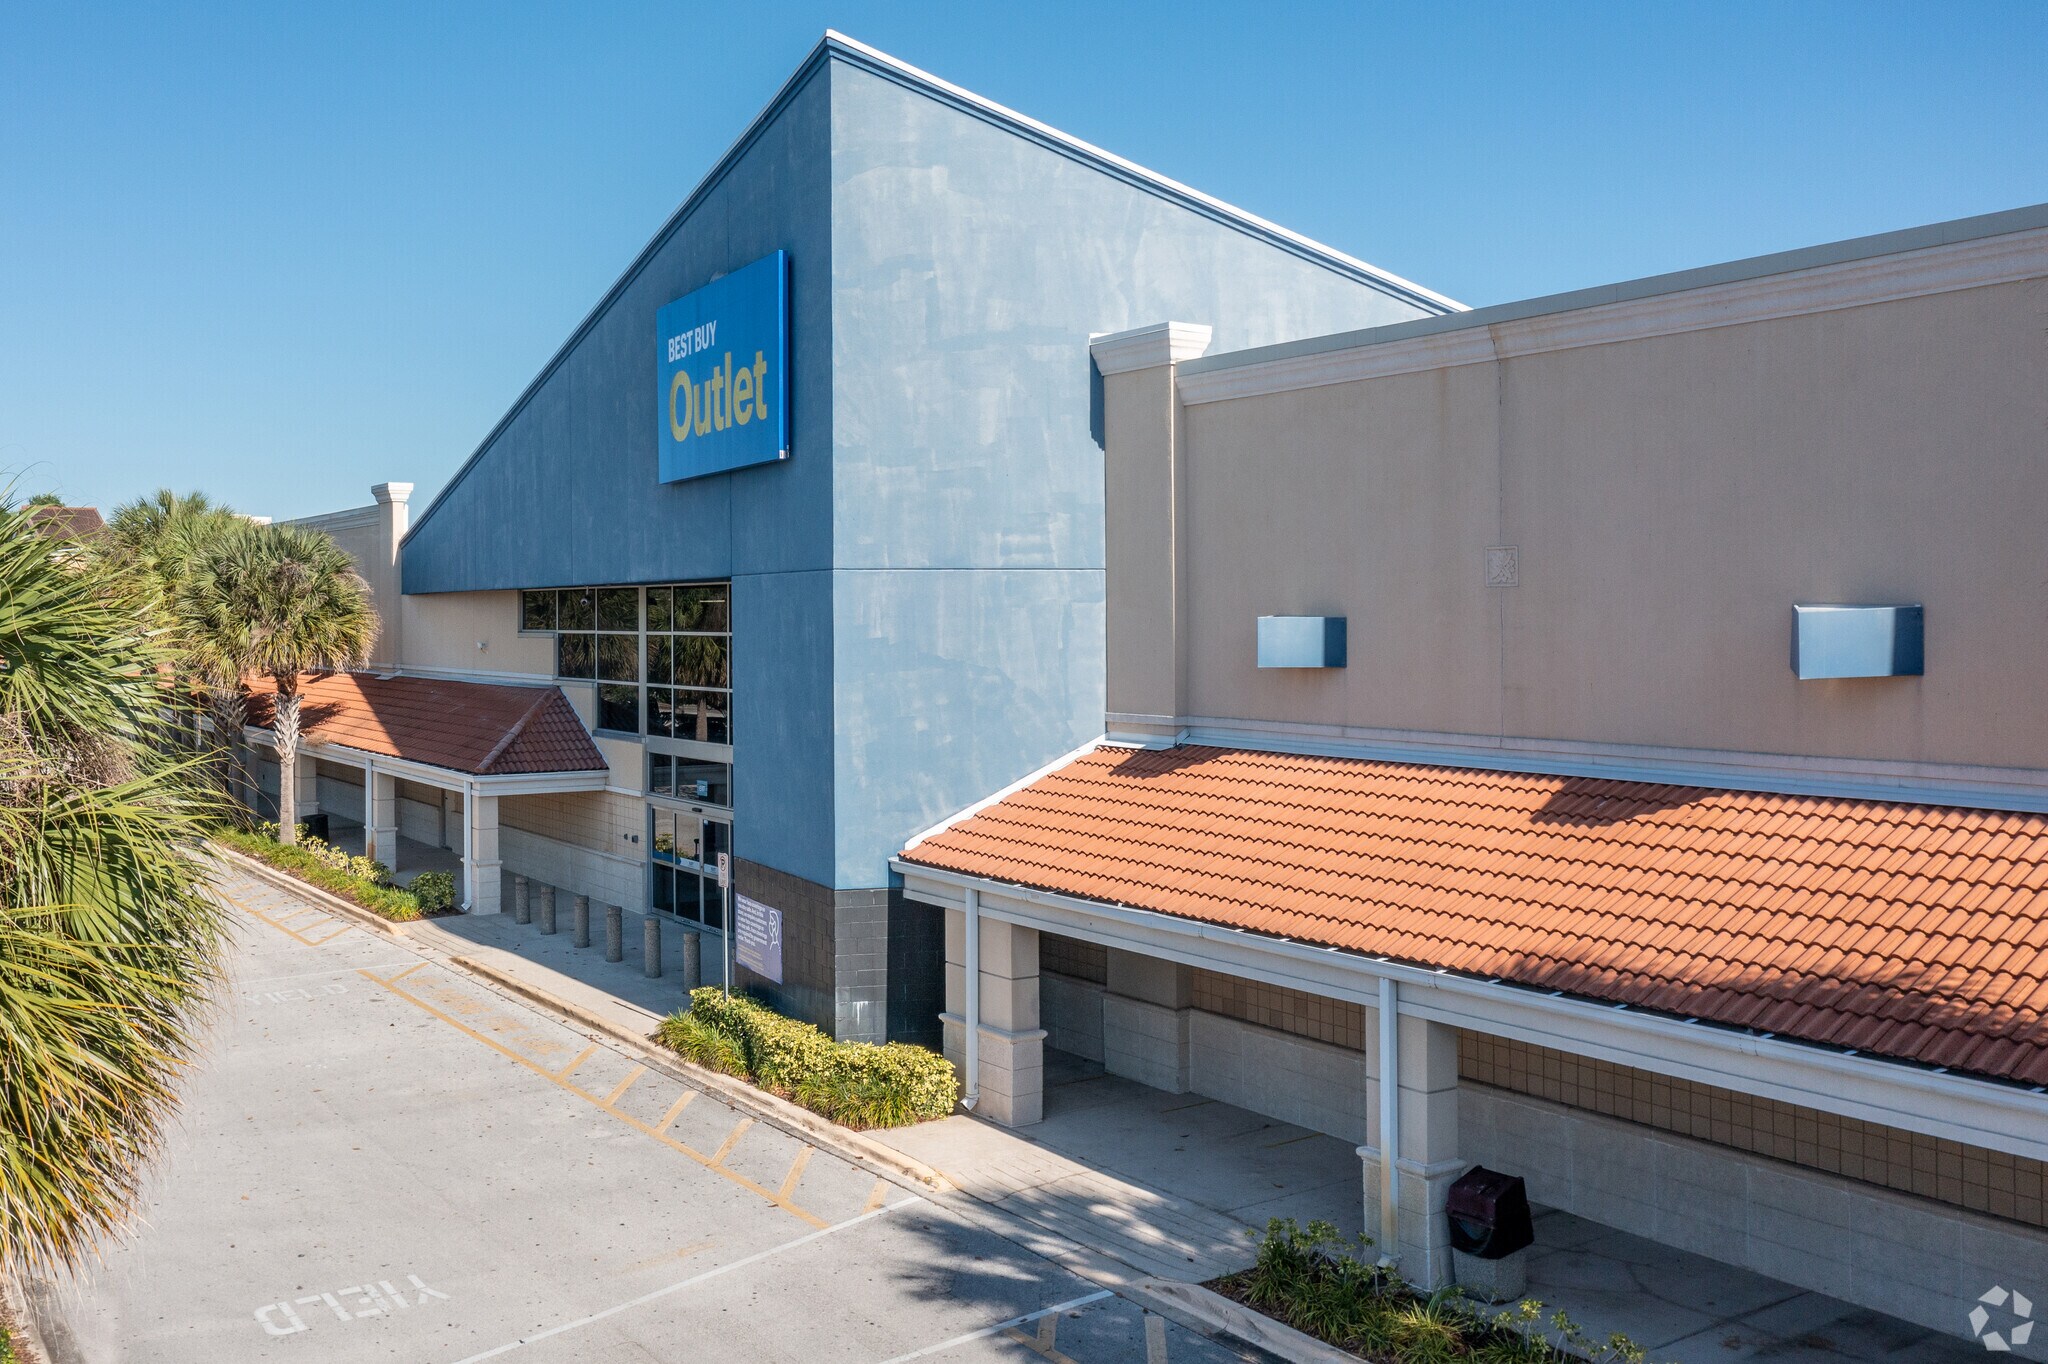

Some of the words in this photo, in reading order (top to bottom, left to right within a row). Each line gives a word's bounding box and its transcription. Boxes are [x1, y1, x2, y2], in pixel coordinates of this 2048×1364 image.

[668, 330, 693, 363] BEST
[695, 320, 717, 352] BUY
[669, 351, 768, 442] Outlet
[253, 1274, 450, 1336] YIELD
